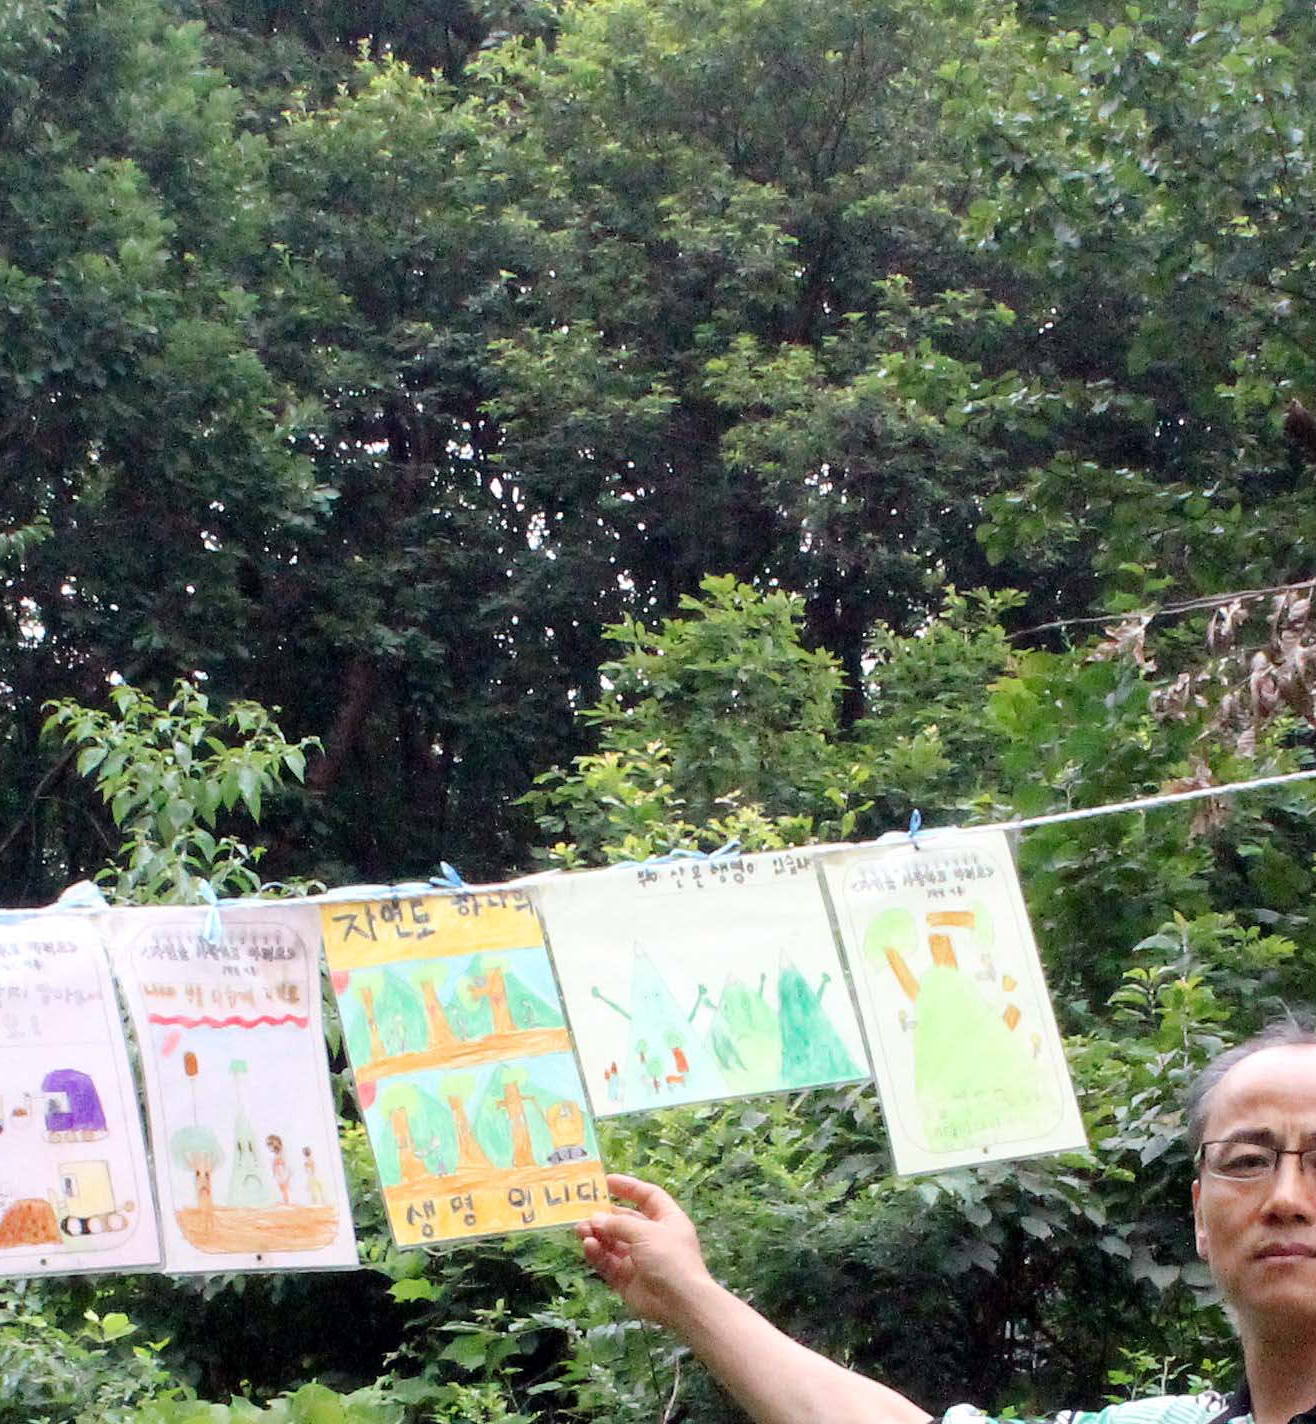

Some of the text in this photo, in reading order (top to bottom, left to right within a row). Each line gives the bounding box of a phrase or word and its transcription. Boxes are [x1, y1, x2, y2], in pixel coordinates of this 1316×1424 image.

[332, 888, 534, 942] 자연도 하나의
[406, 1193, 477, 1238] 생명
